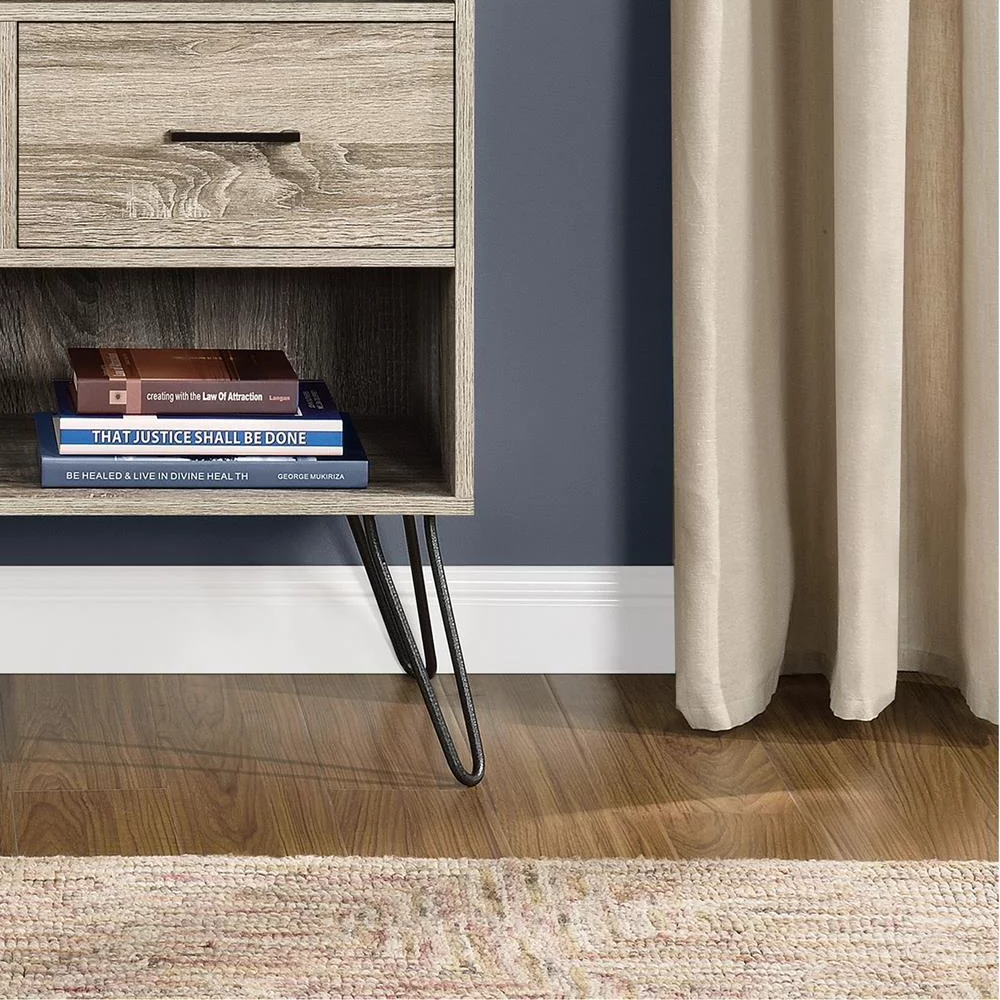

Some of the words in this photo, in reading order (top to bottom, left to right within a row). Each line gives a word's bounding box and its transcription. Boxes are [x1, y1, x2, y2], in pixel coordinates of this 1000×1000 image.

[146, 392, 174, 403] creating
[175, 391, 189, 401] with
[190, 391, 201, 401] the
[202, 391, 217, 401] Law
[218, 391, 227, 401] Of
[228, 391, 263, 402] Attraction
[92, 430, 131, 444] THAT
[133, 430, 191, 444] JUSTICE
[194, 431, 241, 444] SHALL
[244, 431, 262, 444] BE
[265, 431, 307, 445] DONE
[66, 471, 80, 480] BE
[82, 471, 122, 480] HEALED
[124, 471, 132, 480] &
[133, 471, 156, 480] LIVE
[158, 471, 168, 480] IN
[170, 471, 205, 480] DIVINE
